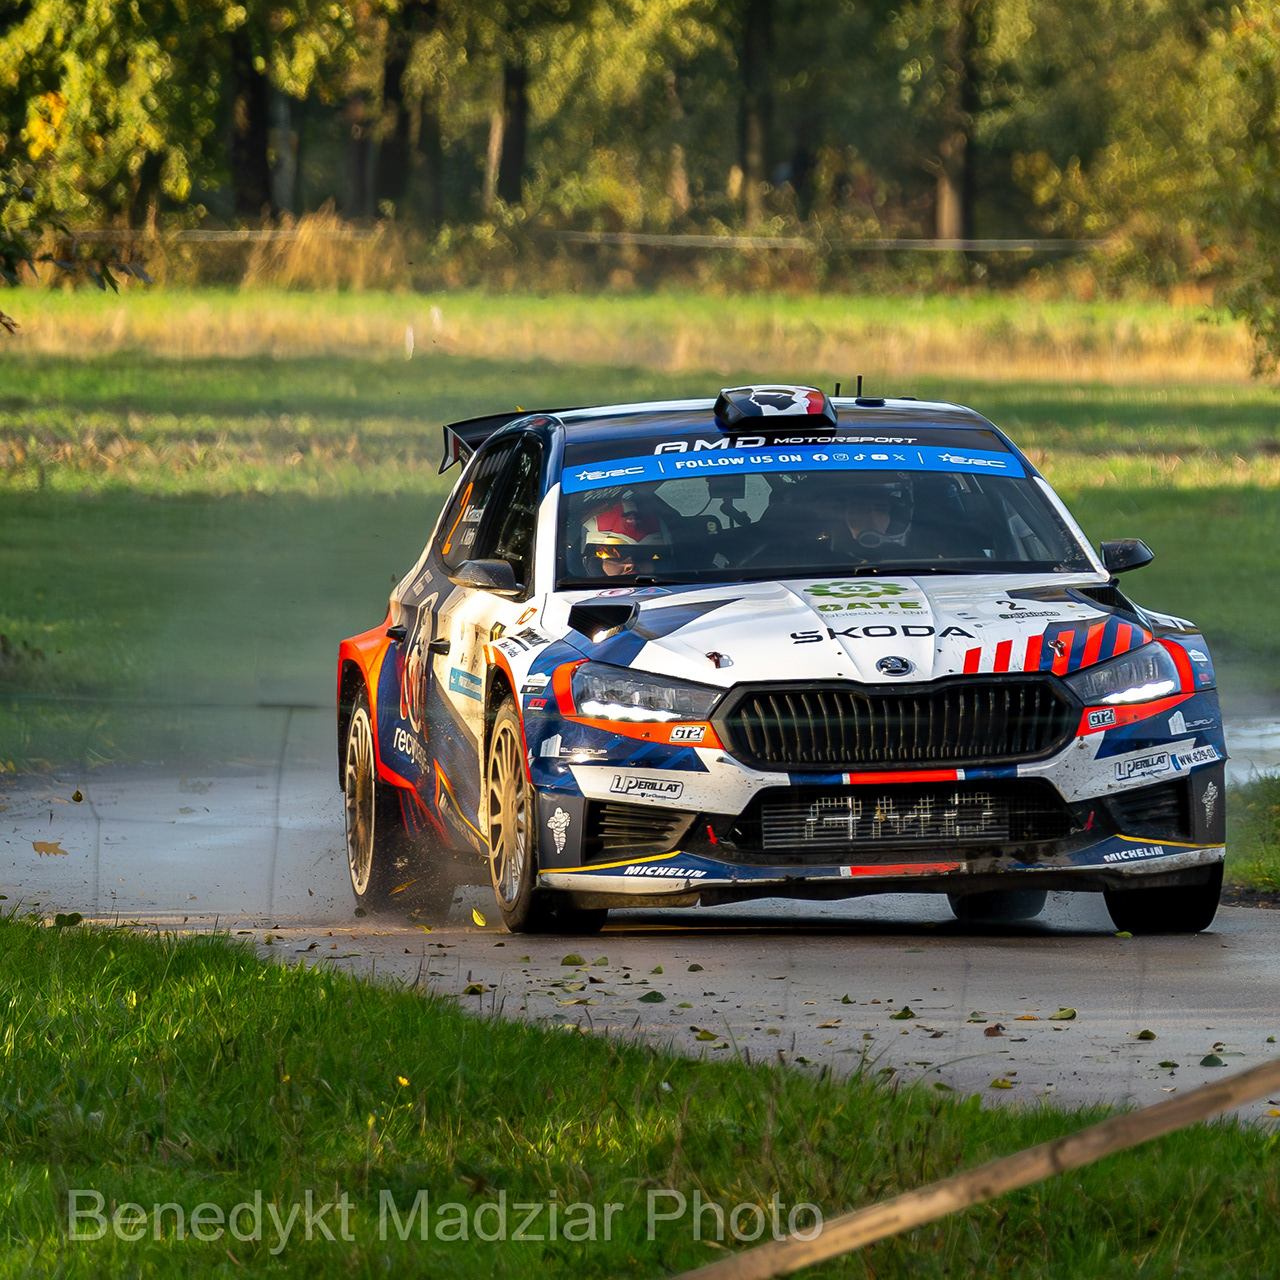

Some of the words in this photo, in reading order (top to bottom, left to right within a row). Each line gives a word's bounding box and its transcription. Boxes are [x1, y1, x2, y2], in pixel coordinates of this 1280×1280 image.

[654, 437, 766, 456] AMD
[773, 436, 918, 445] MOTORSPORT
[675, 457, 744, 469] FOLLOW
[750, 455, 774, 464] US
[778, 454, 802, 463] ON
[442, 482, 474, 555] 2
[995, 600, 1027, 610] 2
[790, 625, 976, 645] SKODA
[1088, 709, 1116, 726] GT2i
[670, 726, 706, 740] GT2i
[1103, 846, 1164, 862] MICHELIN
[624, 866, 707, 878] MICHELIN
